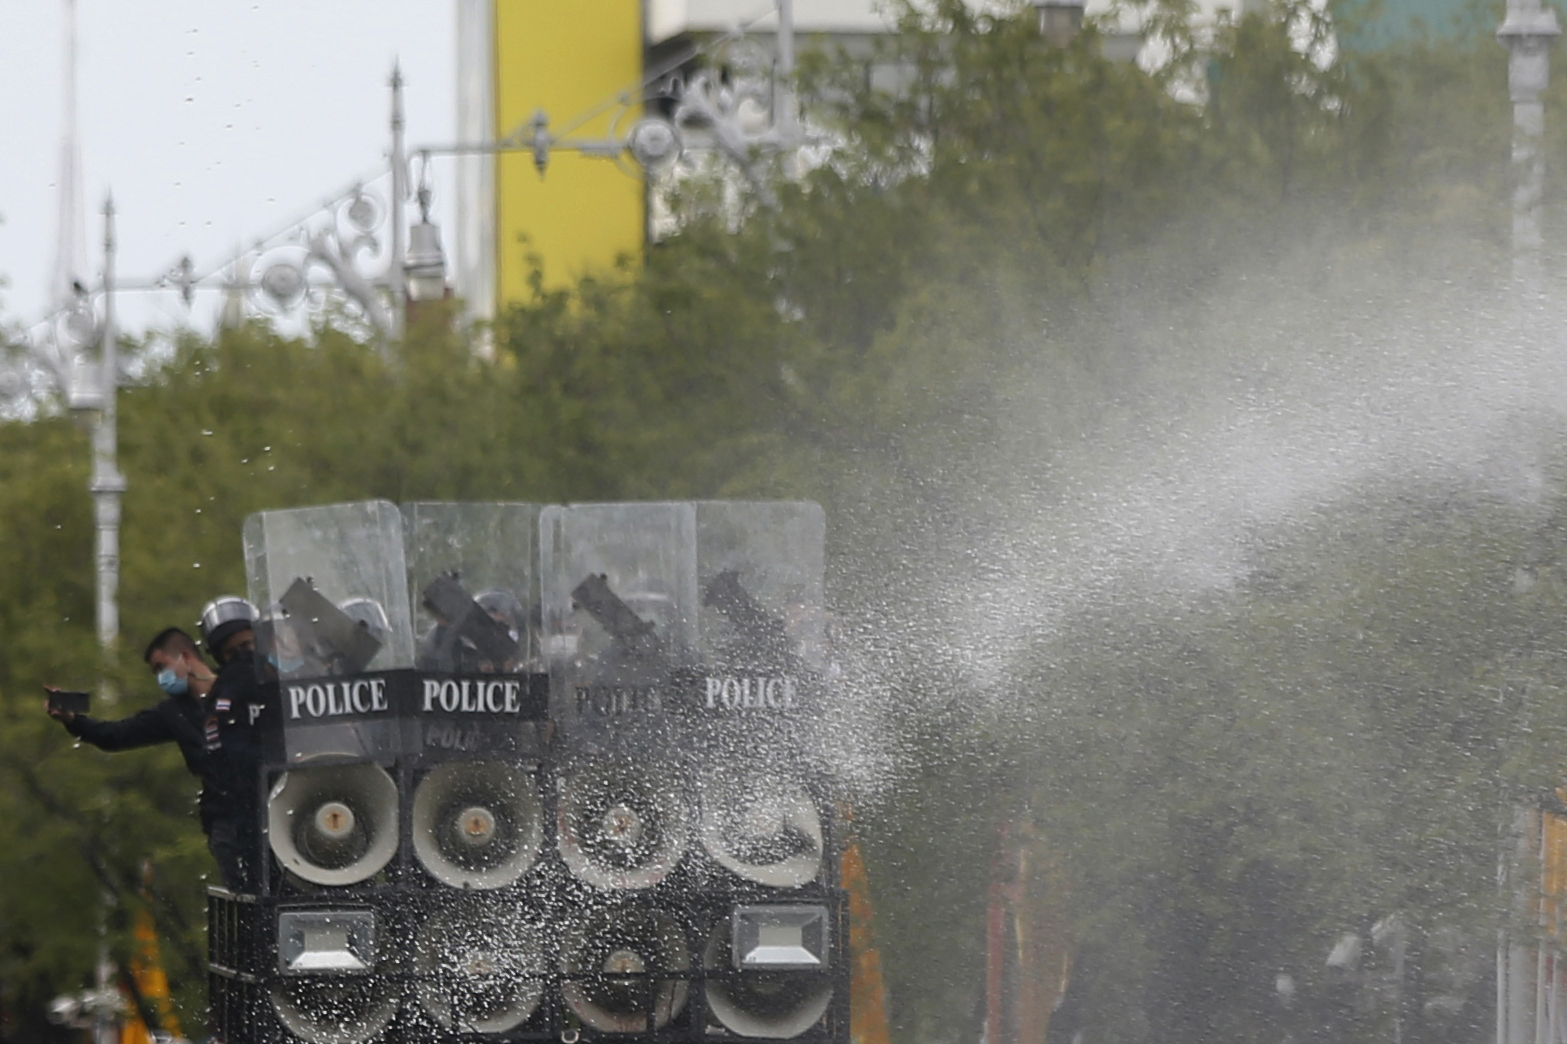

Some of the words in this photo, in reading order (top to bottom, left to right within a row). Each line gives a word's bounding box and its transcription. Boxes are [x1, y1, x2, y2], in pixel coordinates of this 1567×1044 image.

[289, 679, 388, 718] POLICE
[422, 679, 521, 712] POLICE
[705, 676, 799, 709] POLICE
